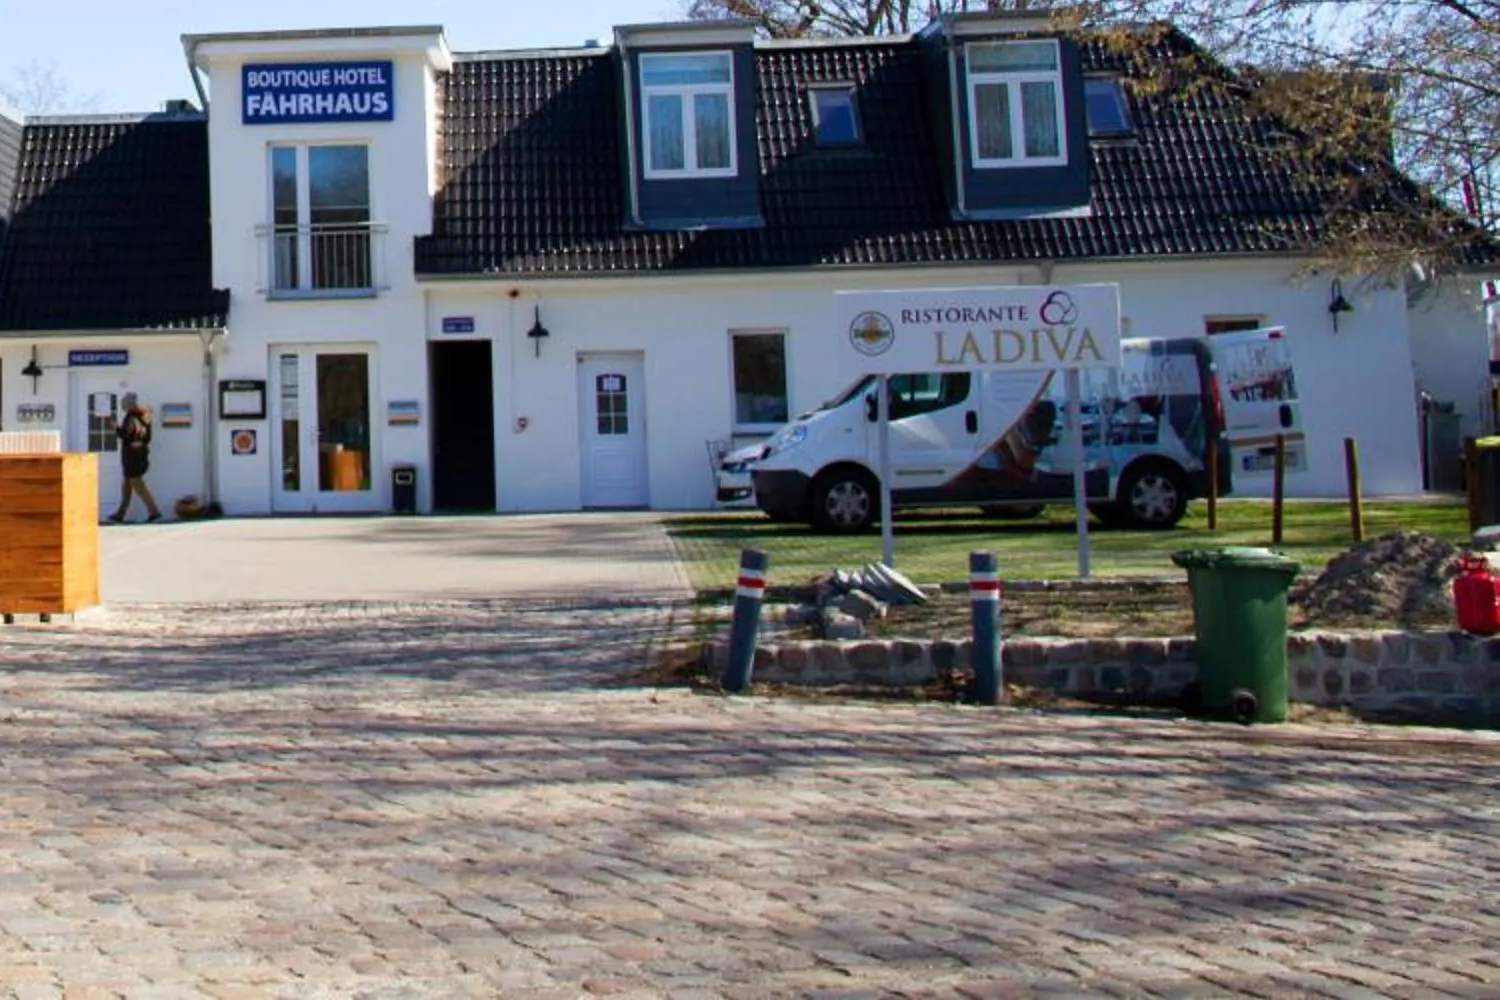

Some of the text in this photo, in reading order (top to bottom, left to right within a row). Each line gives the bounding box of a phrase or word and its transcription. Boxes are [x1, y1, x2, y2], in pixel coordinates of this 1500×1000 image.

[247, 67, 387, 88] BOUTIQUE HOTEL
[247, 91, 389, 116] FÄHRHAUS
[901, 305, 1030, 324] RISTORANTE
